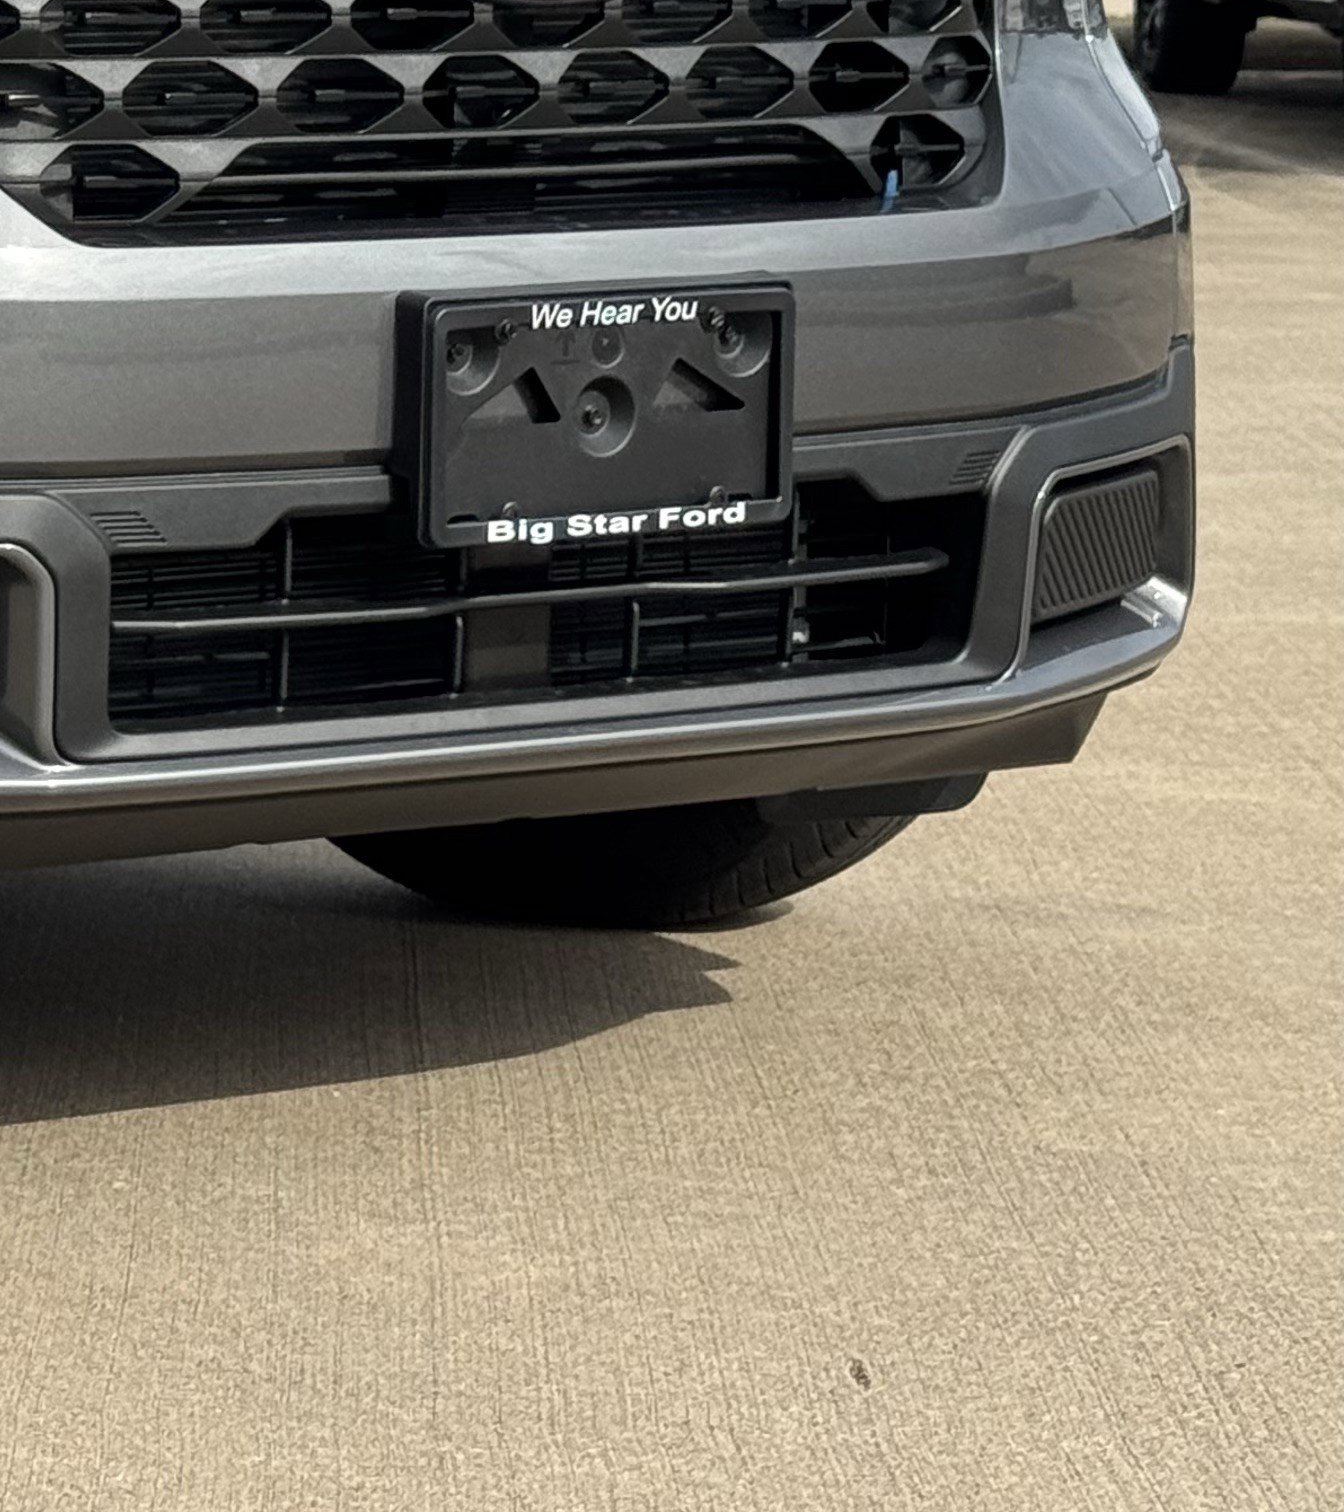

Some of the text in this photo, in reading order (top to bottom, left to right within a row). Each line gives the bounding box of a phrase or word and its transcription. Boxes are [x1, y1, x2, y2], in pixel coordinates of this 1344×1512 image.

[531, 296, 699, 330] We Hear You
[487, 502, 747, 544] Big Star Ford
